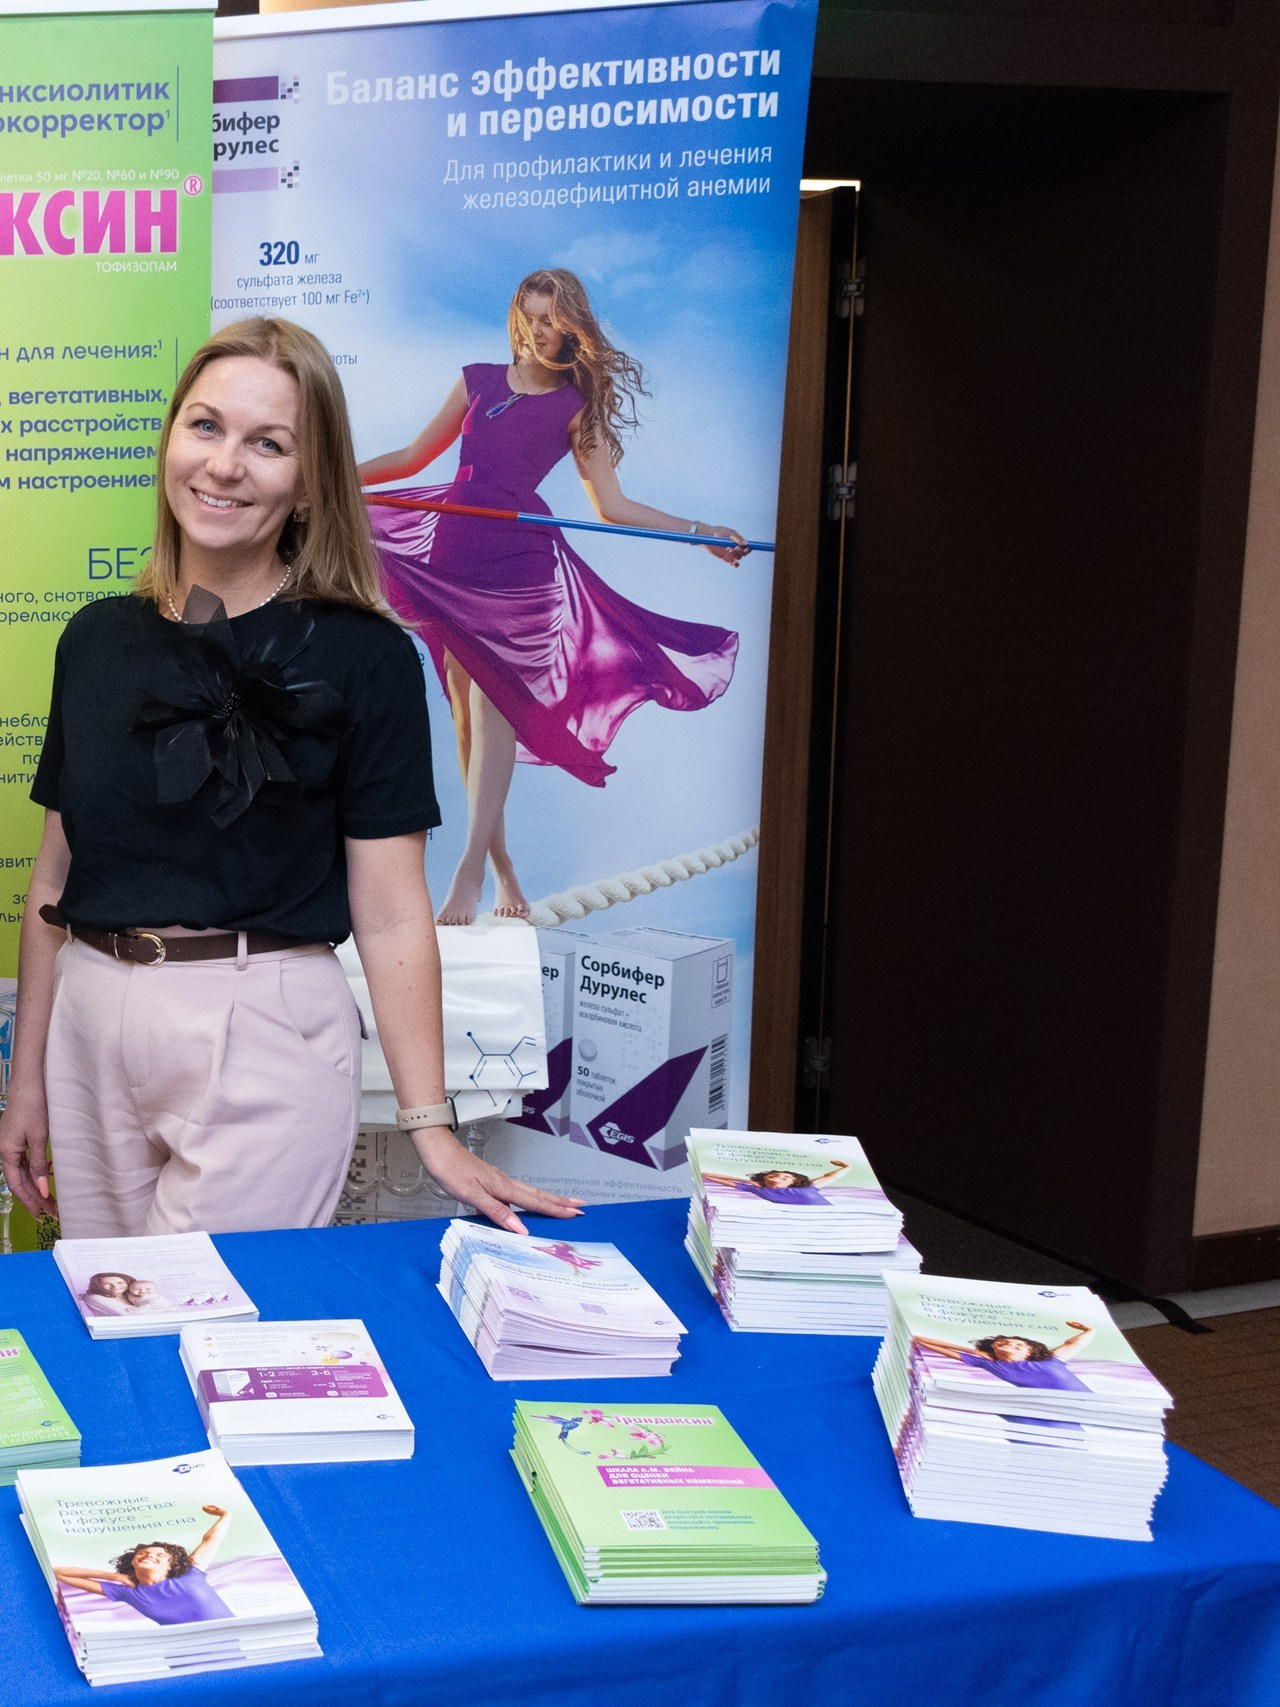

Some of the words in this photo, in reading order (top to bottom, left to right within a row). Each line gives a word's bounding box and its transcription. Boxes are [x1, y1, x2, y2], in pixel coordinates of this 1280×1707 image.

[326, 69, 458, 105] Баланс
[471, 48, 781, 103] эффективности
[212, 111, 281, 136] бифер
[446, 112, 467, 139] и
[479, 90, 779, 142] переносимости
[212, 137, 280, 161] рулес
[36, 171, 51, 183] 50
[54, 172, 68, 183] мг
[71, 169, 102, 183] №20,
[106, 169, 136, 182] №60
[138, 172, 147, 181] и
[149, 168, 180, 181] №90
[443, 159, 485, 186] Для
[492, 152, 651, 181] профилактики
[659, 151, 672, 167] и
[678, 146, 773, 168] лечения
[462, 177, 679, 211] железодефицитной
[686, 177, 771, 198] анемии
[259, 240, 300, 267] 320
[304, 252, 320, 265] мг
[95, 261, 177, 273] ТОФИЗОПАМ
[236, 272, 294, 289] сульфата
[297, 272, 343, 286] железа
[211, 294, 297, 311] (соответствует
[301, 291, 323, 306] 100
[325, 293, 342, 306] мг
[16, 345, 55, 363] для
[8, 388, 168, 407] вегетативных,
[19, 414, 163, 437] расстройств
[581, 955, 665, 990] Сорбифер
[579, 975, 647, 1005] Дурулес
[577, 1065, 590, 1077] 50
[609, 1128, 635, 1144] EGIS
[521, 1174, 600, 1187] Сравнительная
[614, 1414, 714, 1426] Грандаксин
[55, 1494, 149, 1509] Тревожные
[65, 1519, 162, 1535] нарушения
[166, 1515, 196, 1527] сна
[76, 1514, 137, 1527] фокусе
